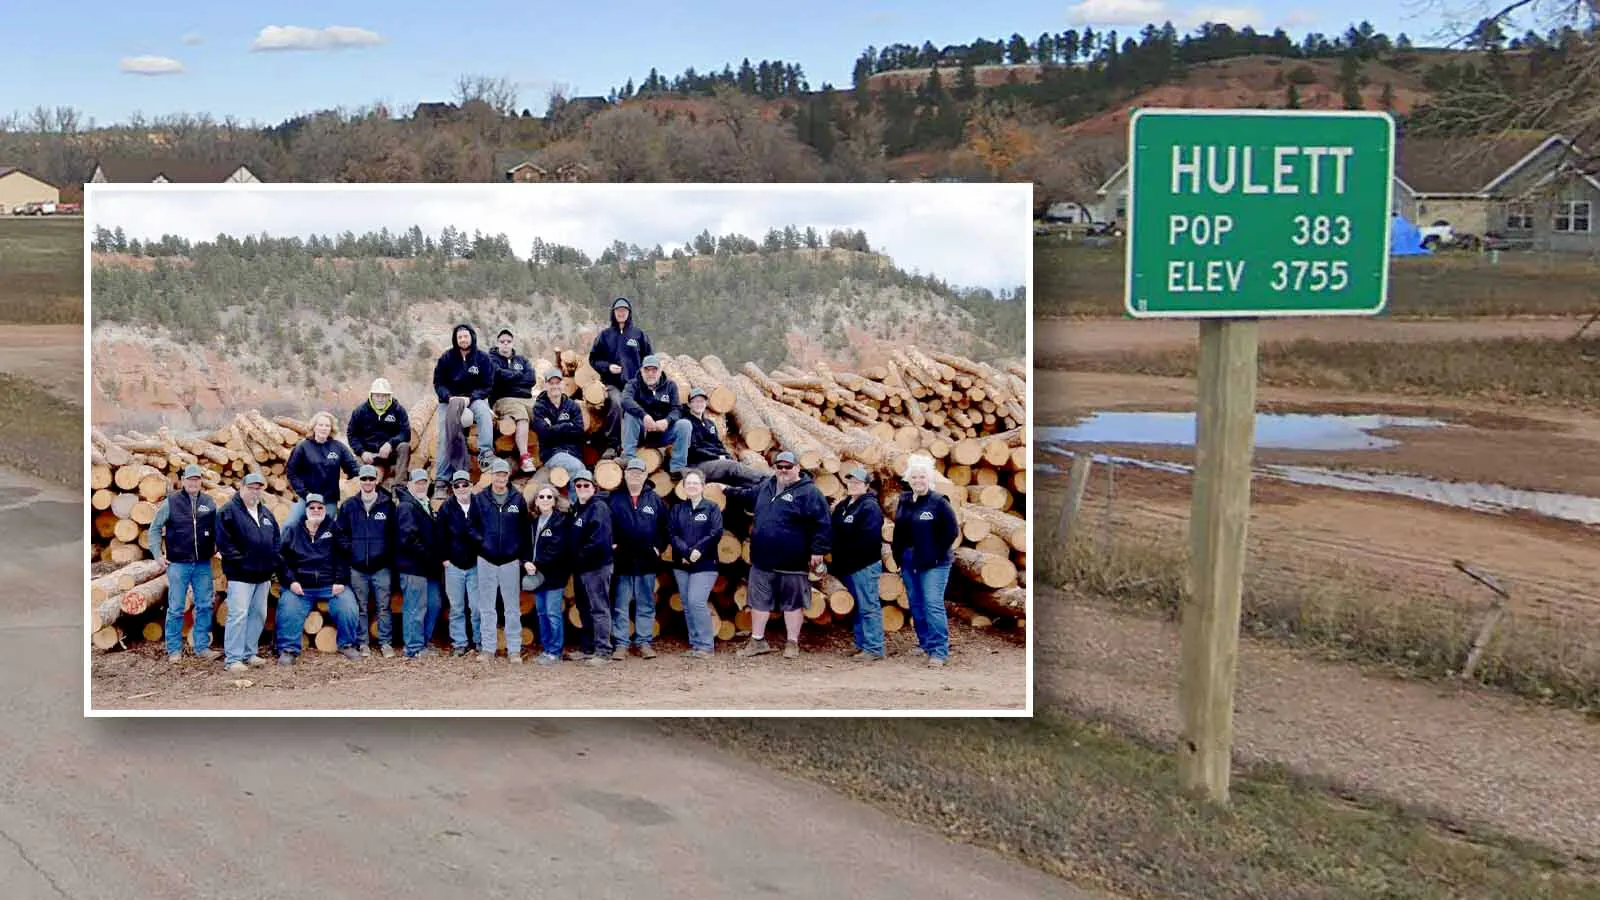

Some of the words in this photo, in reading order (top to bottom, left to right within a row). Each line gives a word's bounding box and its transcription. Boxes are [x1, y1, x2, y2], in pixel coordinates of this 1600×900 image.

[1171, 145, 1354, 194] HULETT
[1169, 215, 1233, 245] POP
[1291, 215, 1351, 245] 383
[1168, 260, 1245, 292] ELEV
[1270, 260, 1349, 291] 3755
